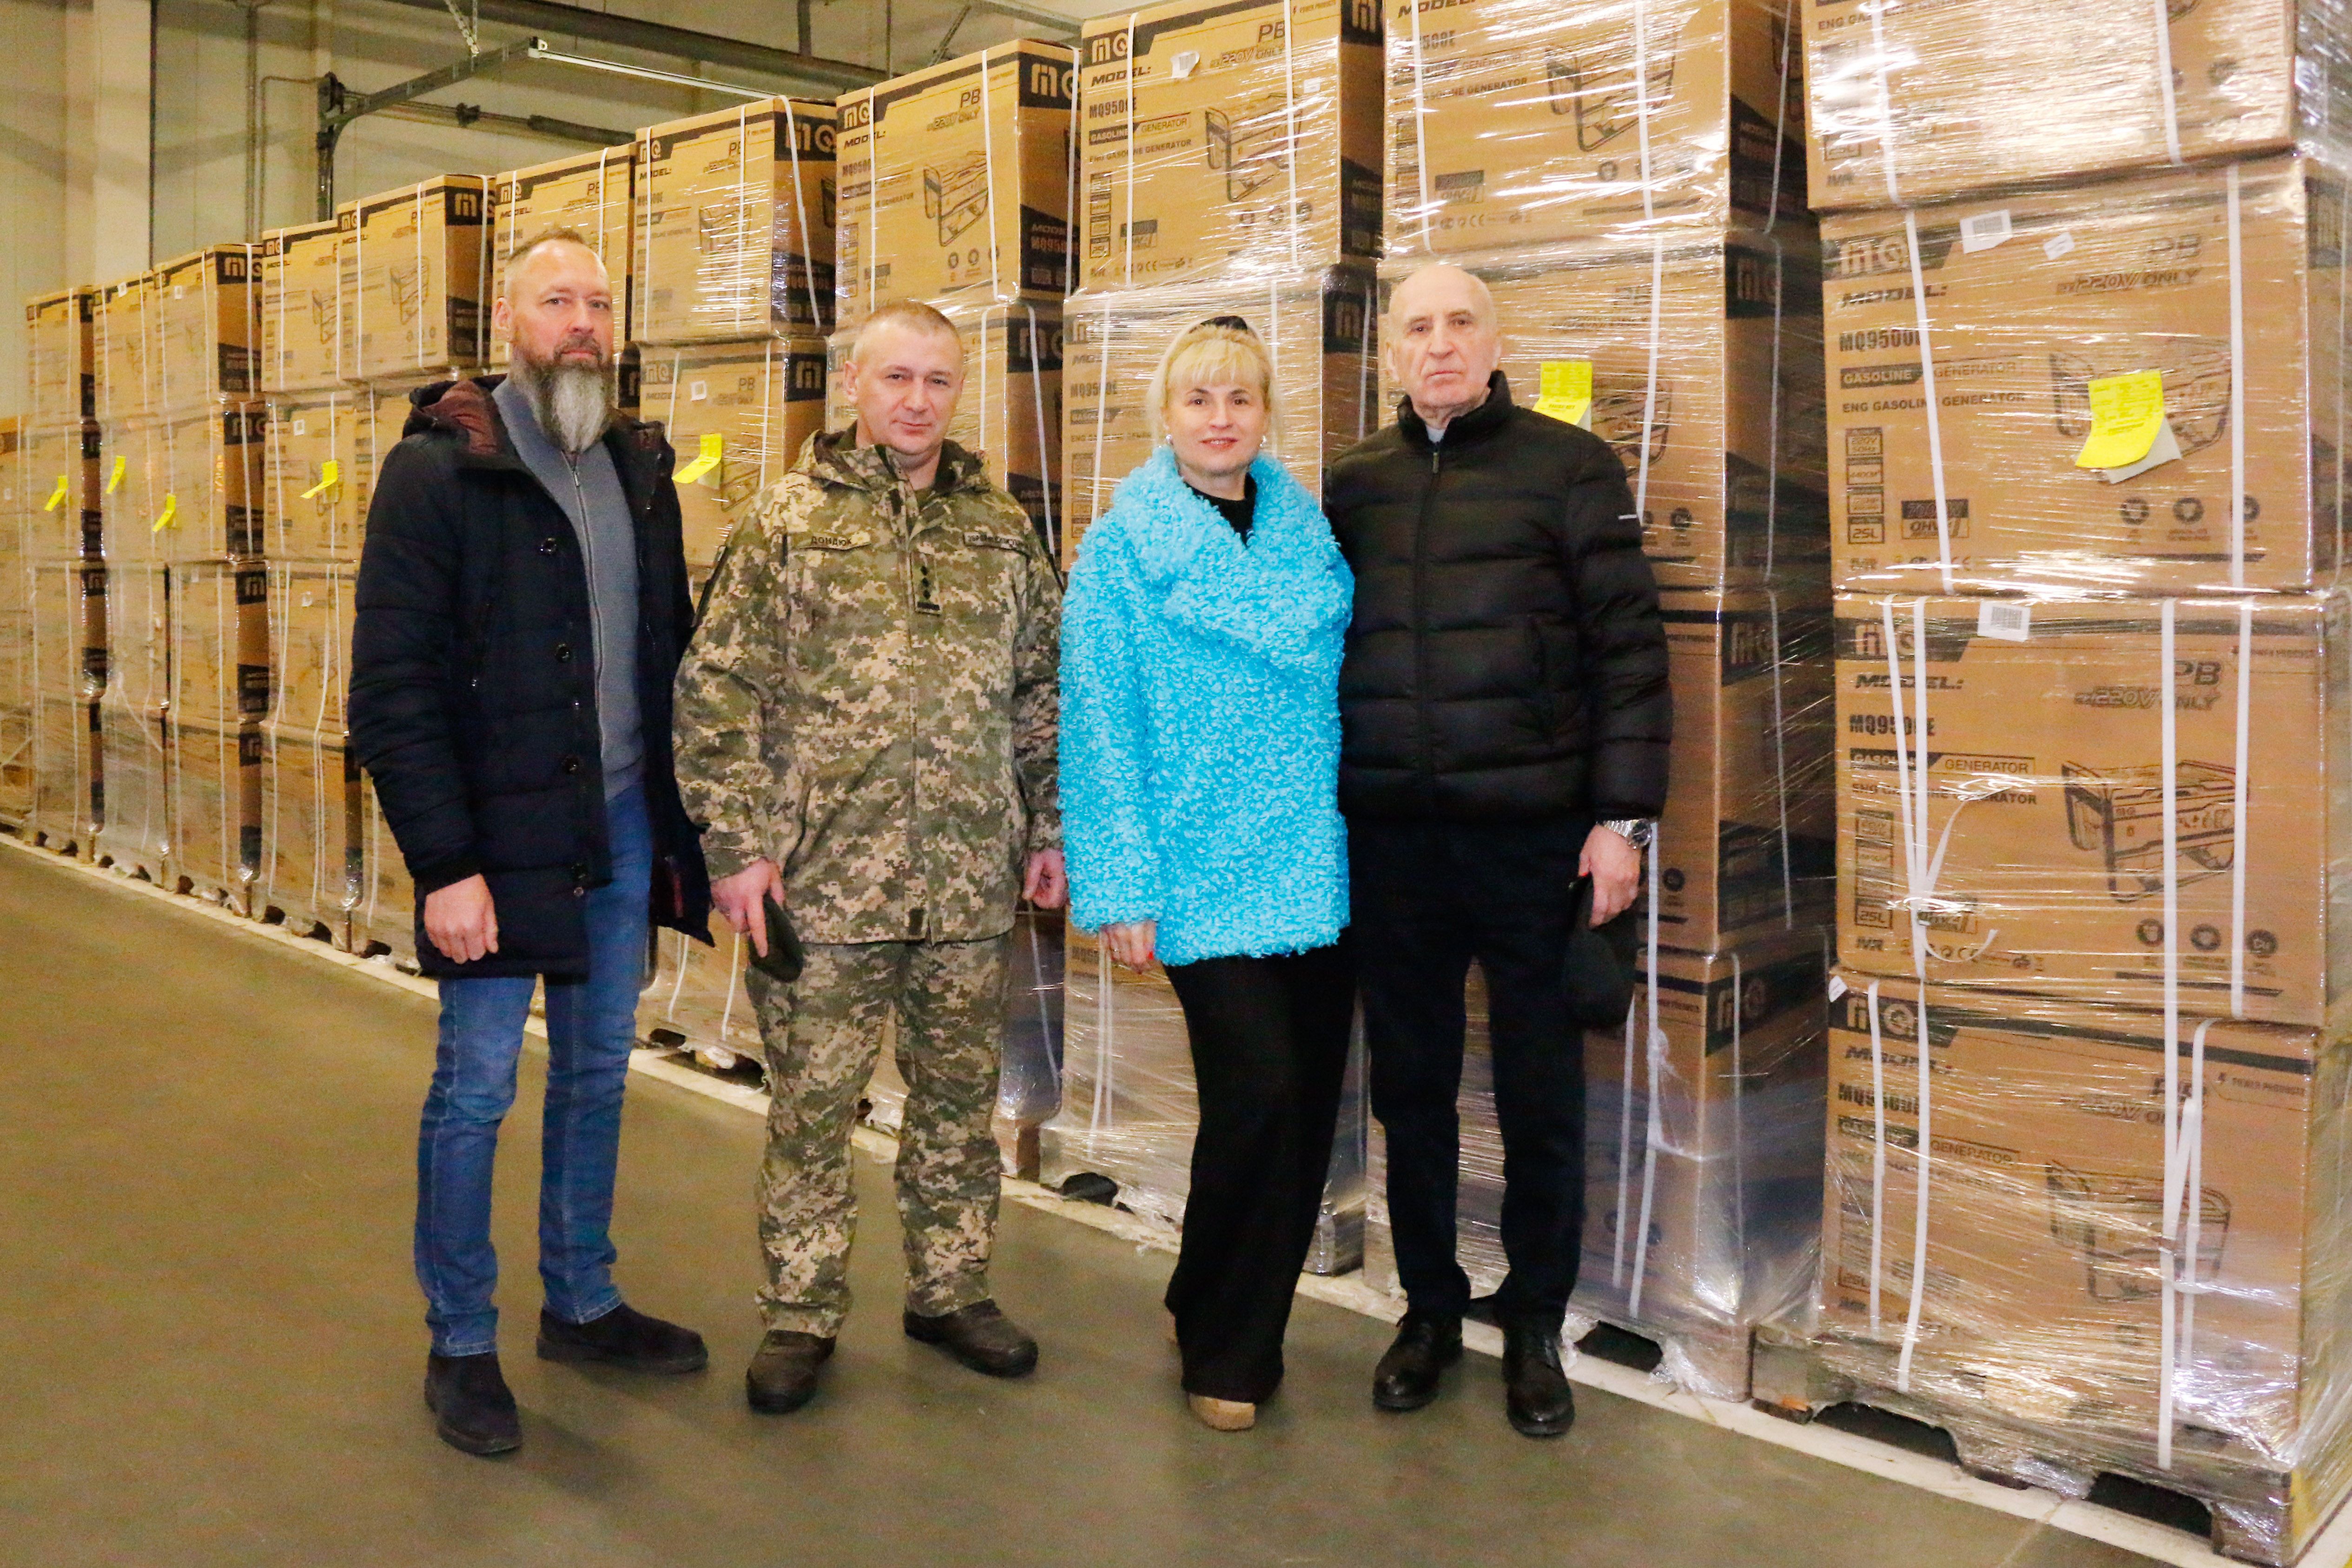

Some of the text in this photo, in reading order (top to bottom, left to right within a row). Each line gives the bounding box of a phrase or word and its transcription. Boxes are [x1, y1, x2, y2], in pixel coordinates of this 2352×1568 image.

[1844, 361, 2017, 384] GASOLINE GENERATOR
[1842, 392, 2026, 413] ENG GASOLIN GENERATOR
[1850, 714, 1935, 736] MQ950E
[1945, 760, 2028, 775] GENERATOR
